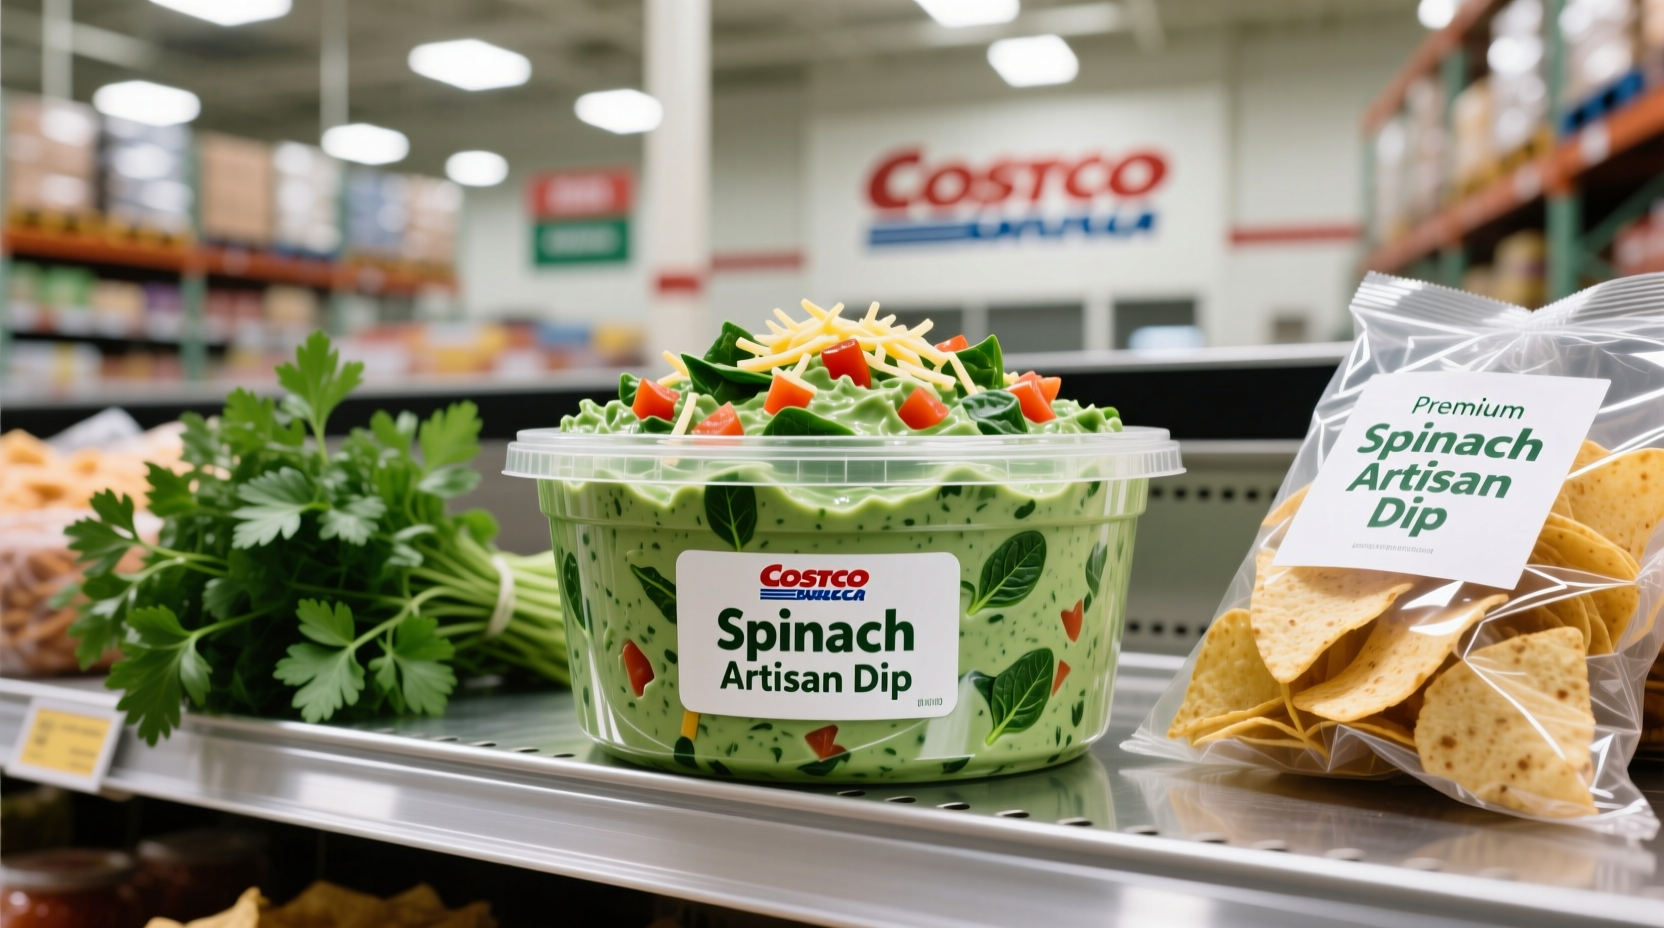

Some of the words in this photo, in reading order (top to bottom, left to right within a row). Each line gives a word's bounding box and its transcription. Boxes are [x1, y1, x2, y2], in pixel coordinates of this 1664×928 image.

[866, 148, 1170, 211] COSTCO
[1411, 396, 1525, 419] Premium
[1357, 422, 1543, 462] Spinach
[1345, 460, 1512, 498] Artisan
[1366, 496, 1448, 537] Dip
[760, 564, 870, 588] COSTCO
[717, 608, 915, 662] Spinach
[720, 661, 843, 693] Artisan
[854, 661, 912, 700] Dip
